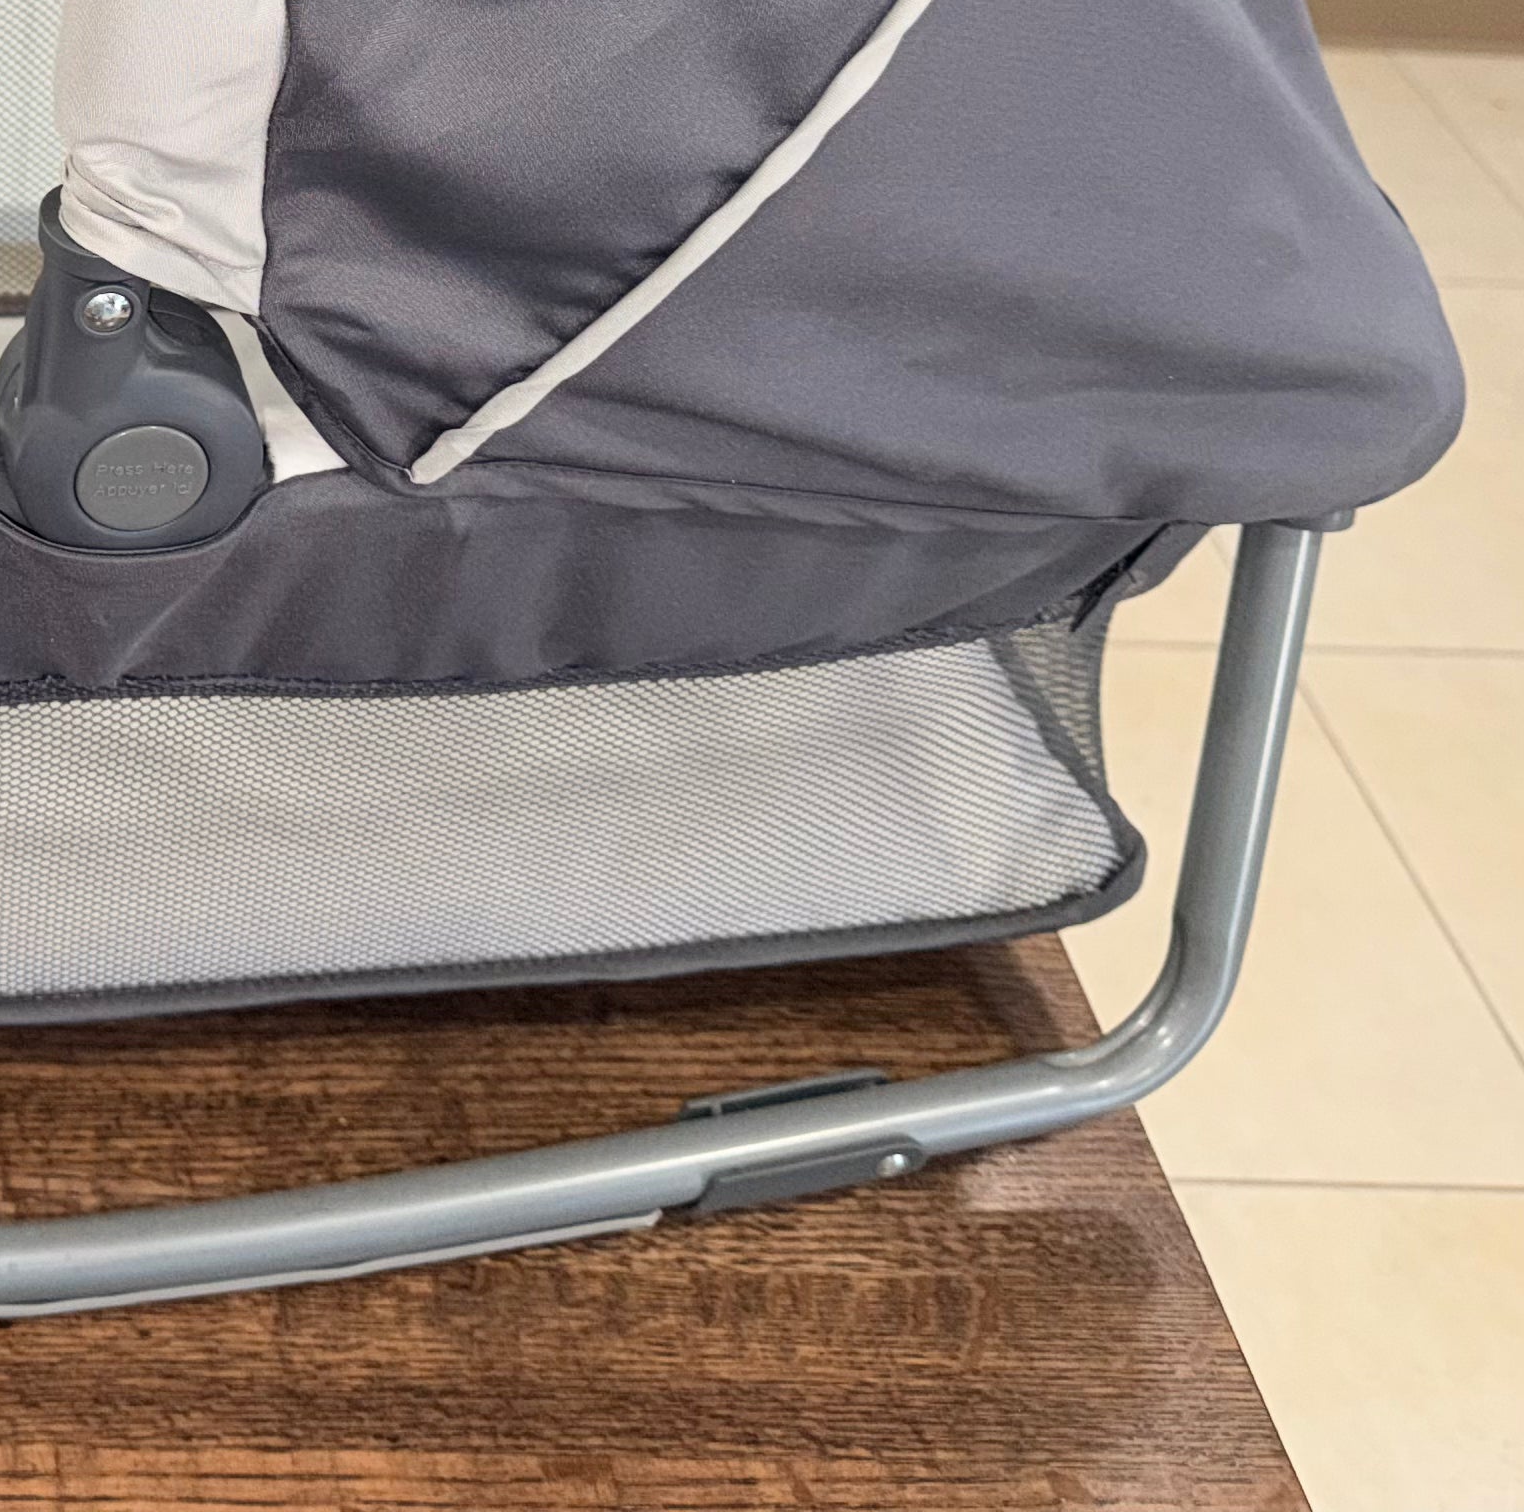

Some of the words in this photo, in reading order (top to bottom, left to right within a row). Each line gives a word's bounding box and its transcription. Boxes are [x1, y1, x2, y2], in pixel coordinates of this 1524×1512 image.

[96, 463, 143, 477] Press
[153, 461, 194, 475] Here
[94, 483, 166, 498] Appuyer
